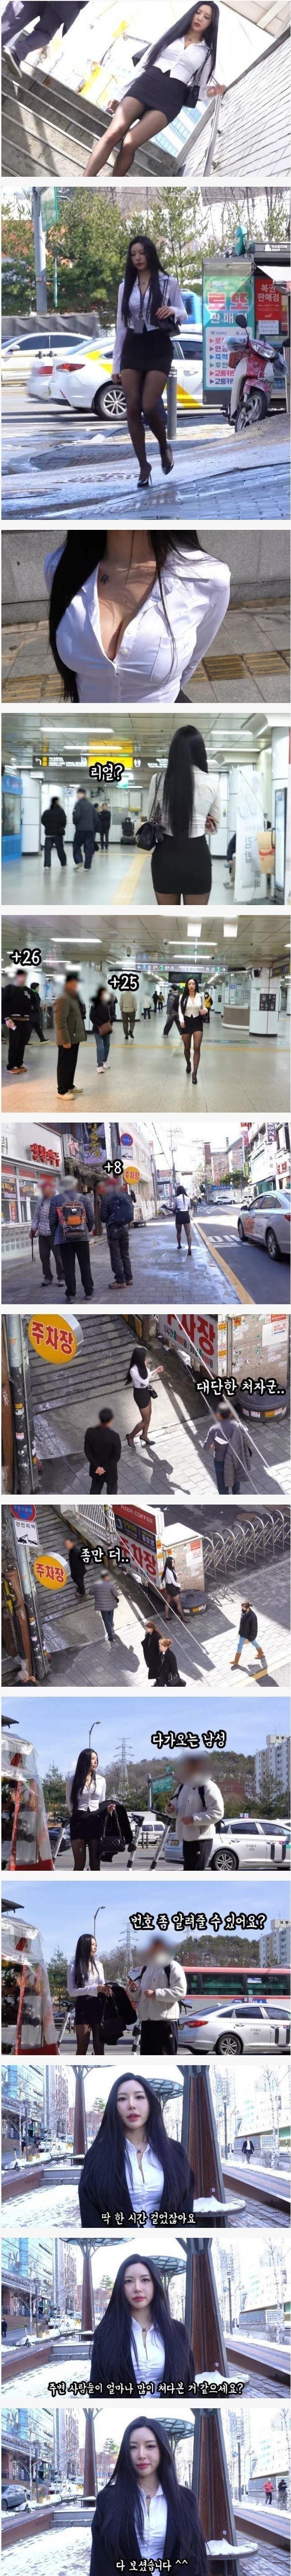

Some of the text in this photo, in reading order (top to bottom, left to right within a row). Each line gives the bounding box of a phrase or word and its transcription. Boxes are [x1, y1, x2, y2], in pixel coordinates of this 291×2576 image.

[261, 284, 276, 293] 복권
[207, 292, 249, 311] 로또
[258, 293, 279, 302] 판매점
[125, 1171, 140, 1180] 주차장
[31, 1320, 74, 1355] 주차장
[134, 1511, 153, 1524] COFFEE
[142, 1534, 155, 1546] 동창생
[119, 1536, 156, 1576] 주차장
[36, 1563, 64, 1583] 주차장
